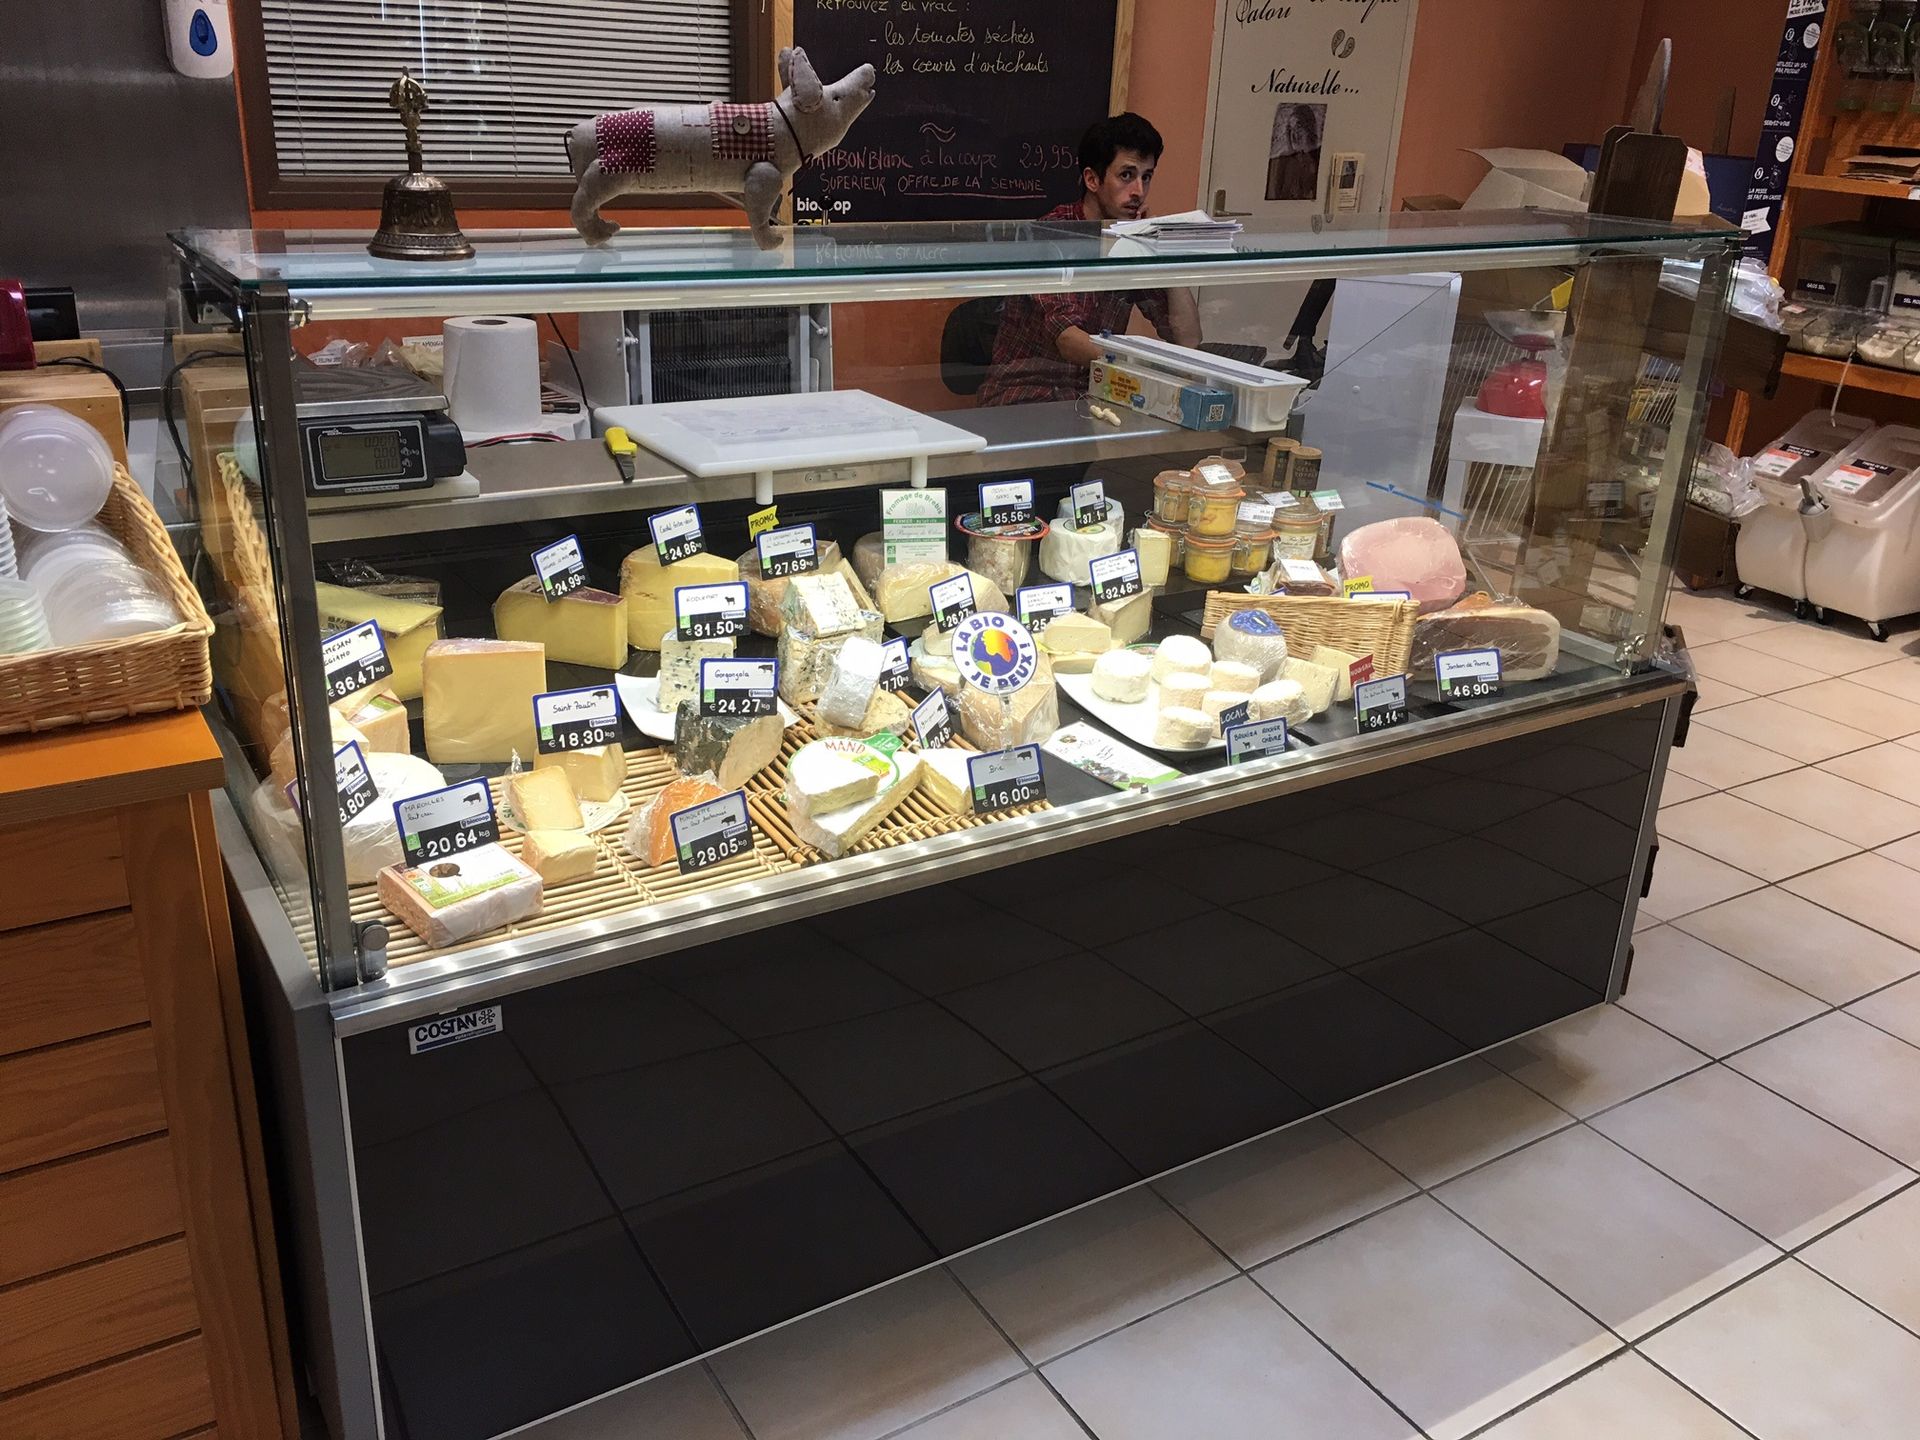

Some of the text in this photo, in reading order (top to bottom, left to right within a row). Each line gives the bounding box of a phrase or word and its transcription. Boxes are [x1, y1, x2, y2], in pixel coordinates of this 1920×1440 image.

[908, 21, 975, 45] tomates
[796, 197, 851, 215] bioop
[750, 513, 774, 529] PROMO
[669, 541, 697, 560] 24.86
[774, 559, 807, 575] 27.69
[555, 573, 581, 596] 24.99
[1105, 582, 1133, 599] 32.48
[1345, 580, 1369, 592] PROMO
[693, 620, 734, 637] 31.50
[956, 616, 1005, 651] LA BIO
[335, 665, 375, 695] 36.47
[971, 671, 991, 689] JE
[997, 653, 1032, 689] PEUX
[1453, 683, 1489, 697] 46.90
[718, 699, 761, 714] 24.27
[1220, 708, 1245, 724] LOCAL
[1370, 710, 1397, 728] 34.14
[559, 728, 604, 748] 18.30
[990, 786, 1030, 807] 16.00
[427, 829, 477, 857] 20.64
[697, 837, 738, 866] 28.05
[414, 1013, 477, 1042] COSTAN
